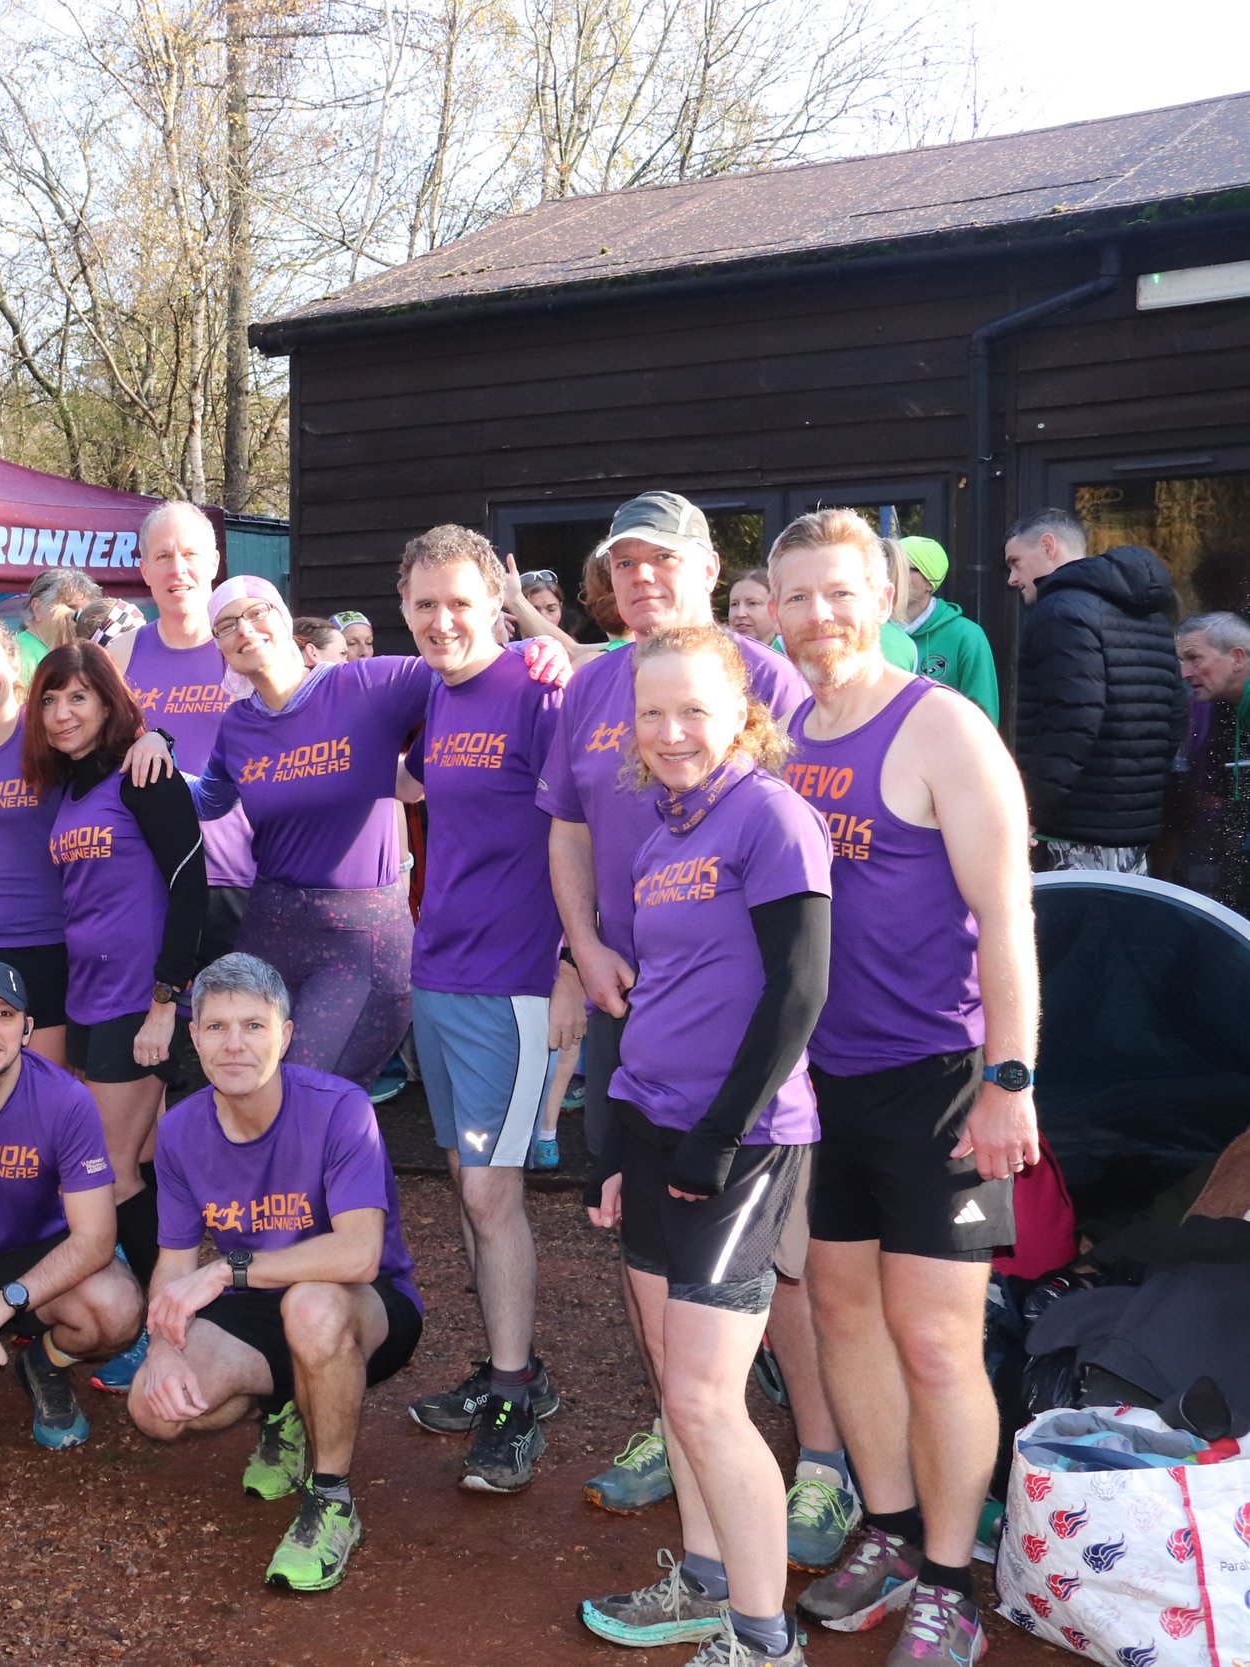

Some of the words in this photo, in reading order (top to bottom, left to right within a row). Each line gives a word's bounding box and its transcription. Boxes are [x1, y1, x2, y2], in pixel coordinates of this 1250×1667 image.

[276, 736, 350, 771] HOOK
[444, 732, 508, 755] HOOK
[271, 757, 350, 783] RUNNERS
[439, 753, 502, 769] RUNNERS
[59, 826, 114, 852] HOOK
[651, 856, 721, 892] HOOK
[251, 1193, 311, 1221] HOOK
[251, 1215, 314, 1233] RUNNERS
